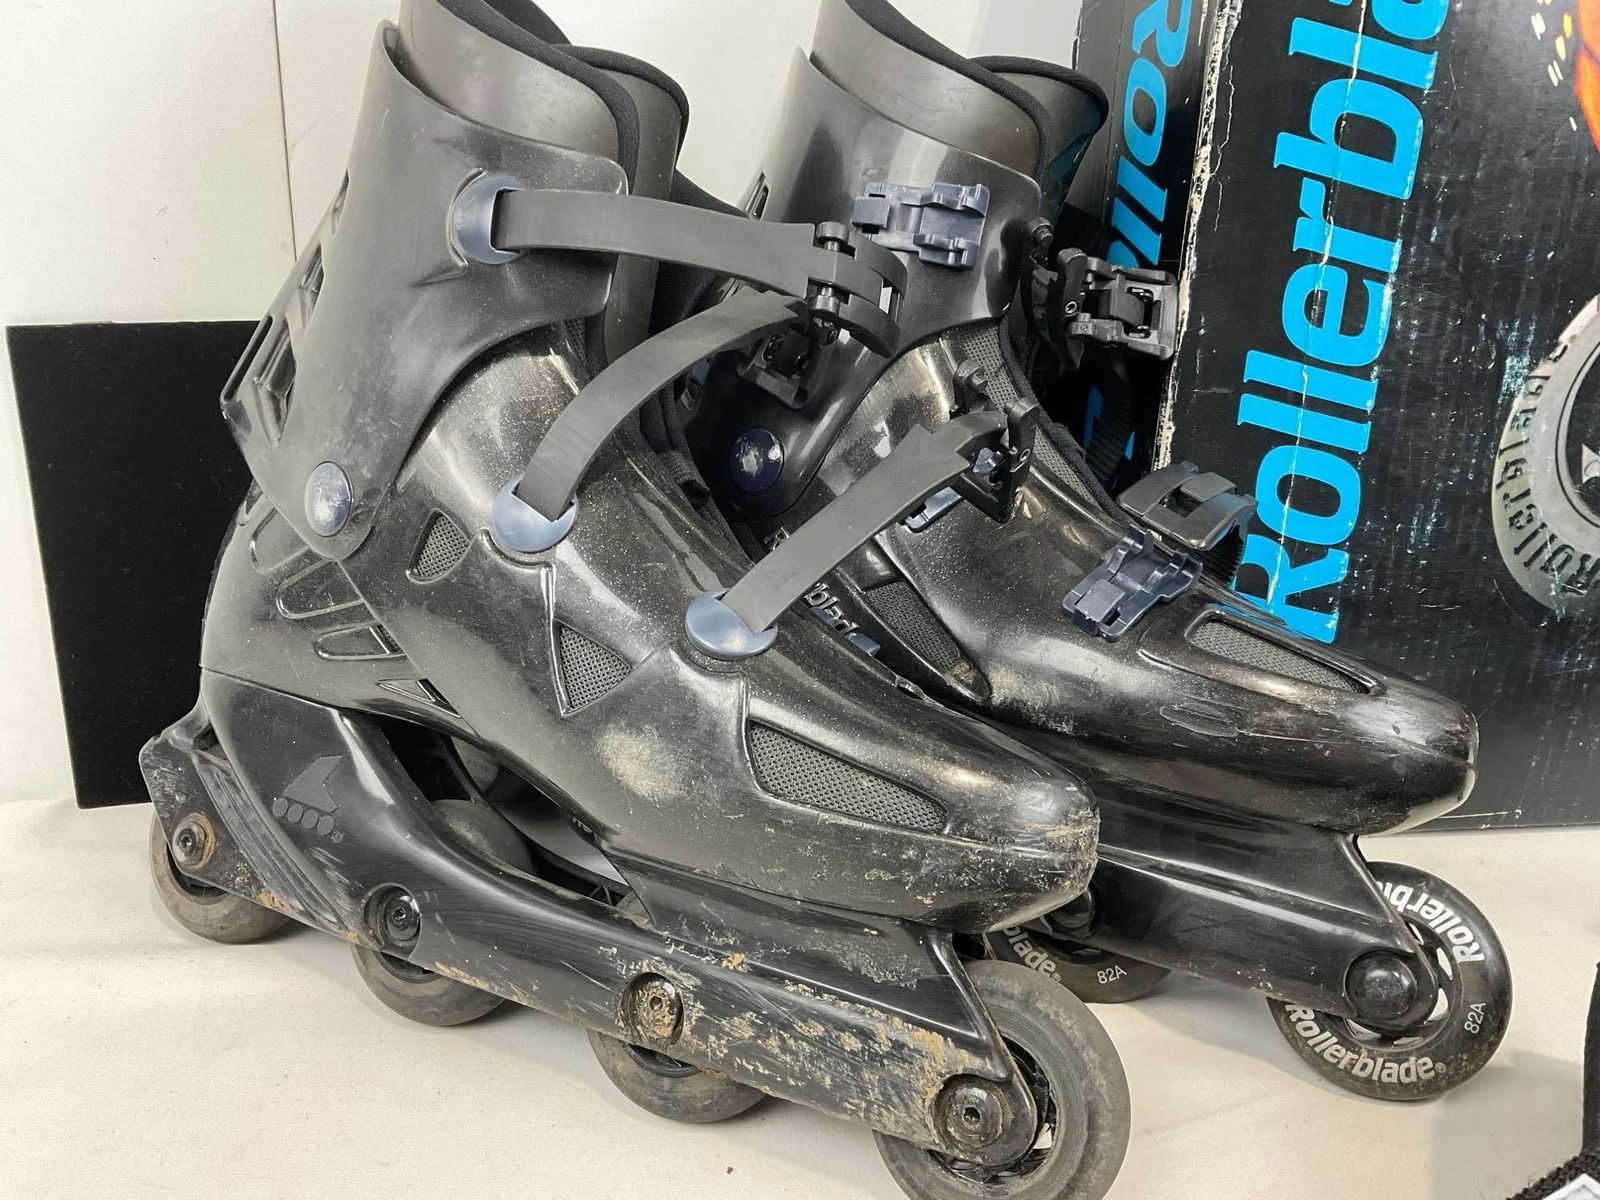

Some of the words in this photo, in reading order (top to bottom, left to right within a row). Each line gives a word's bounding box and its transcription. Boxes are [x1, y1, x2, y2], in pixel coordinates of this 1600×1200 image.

[1106, 0, 1192, 268] Roll
[1377, 881, 1485, 963] Rollerbl
[1097, 965, 1127, 984] 82A
[1464, 1002, 1486, 1034] 82A
